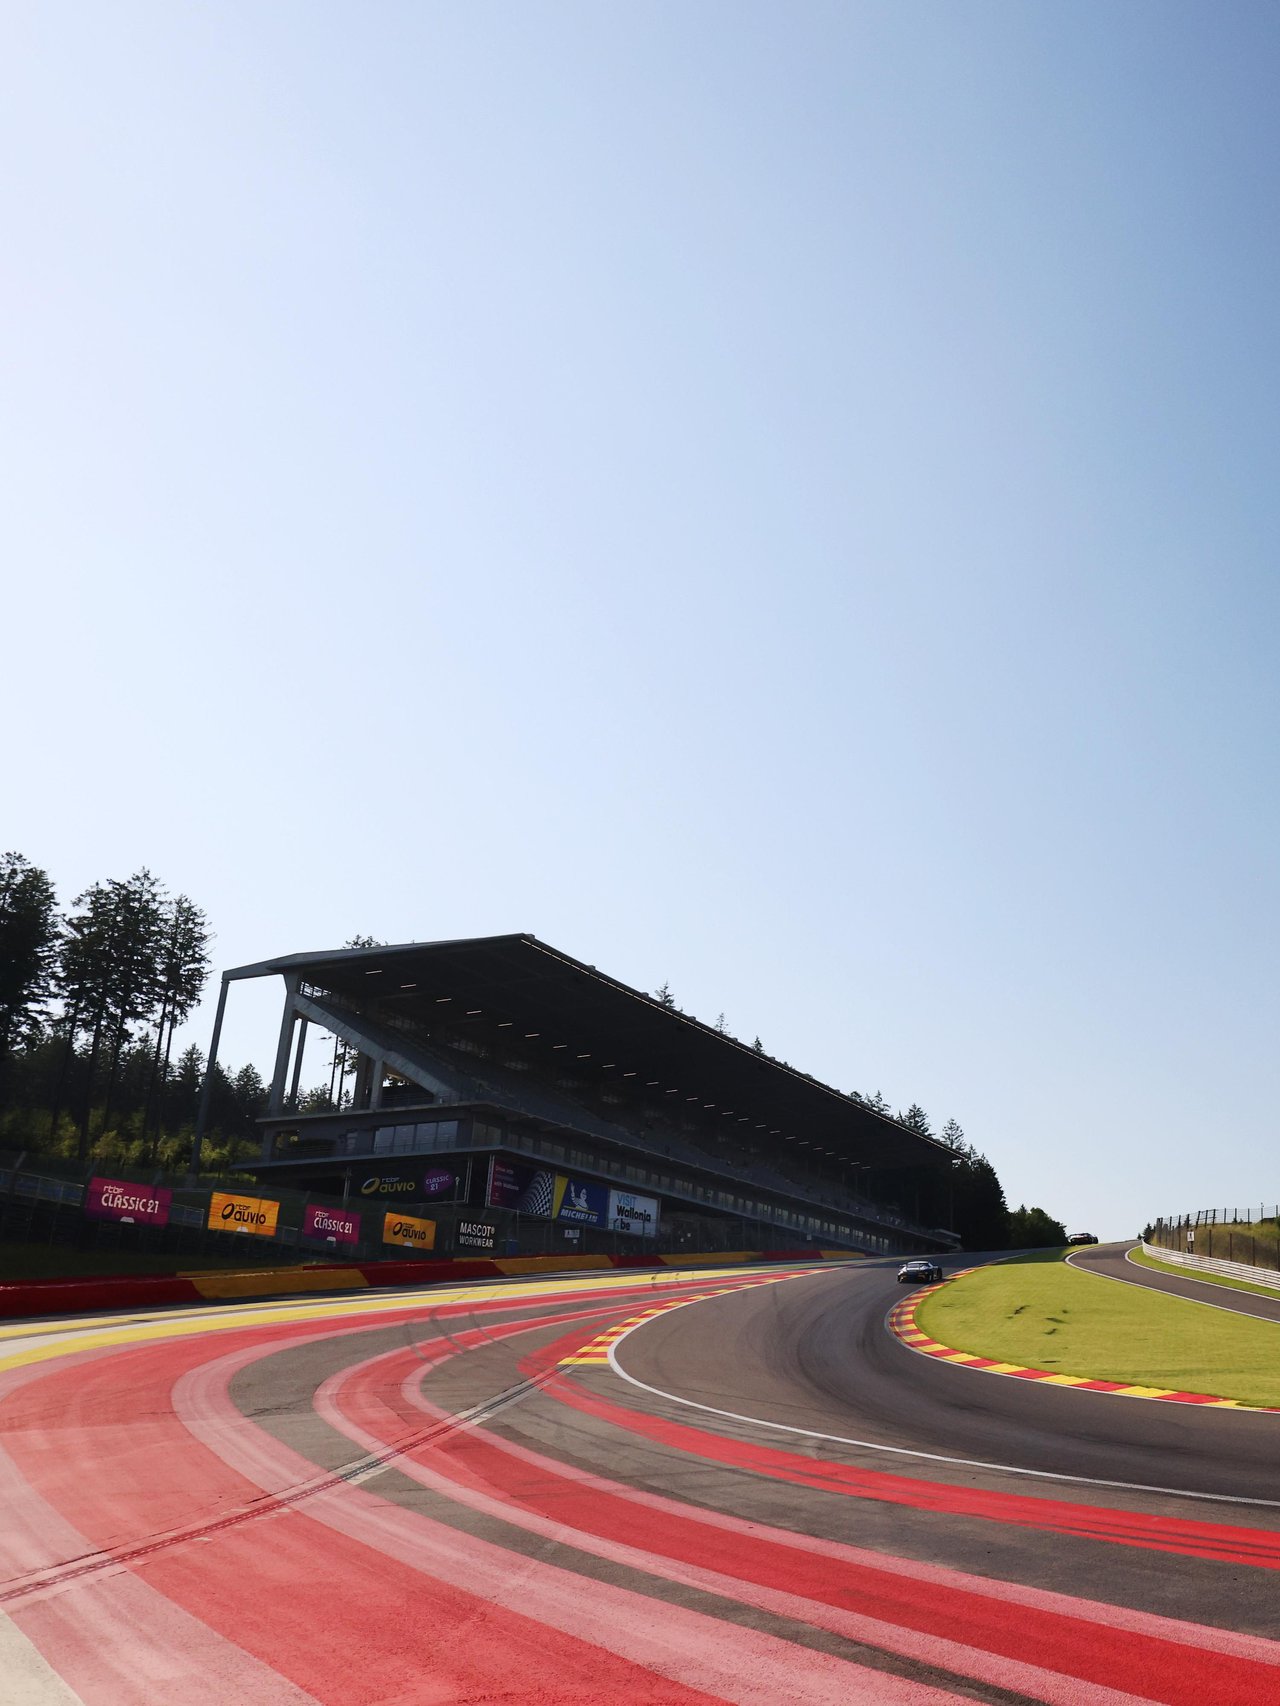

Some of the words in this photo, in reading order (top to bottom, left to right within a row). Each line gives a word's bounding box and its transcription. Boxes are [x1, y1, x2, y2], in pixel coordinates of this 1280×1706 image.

[147, 1199, 159, 1214] 21
[617, 1193, 638, 1207] VISIT
[560, 1208, 598, 1223] MICHELIN
[616, 1204, 651, 1222] Wallonia
[344, 1222, 353, 1234] 21
[459, 1235, 494, 1248] WORKWEAR
